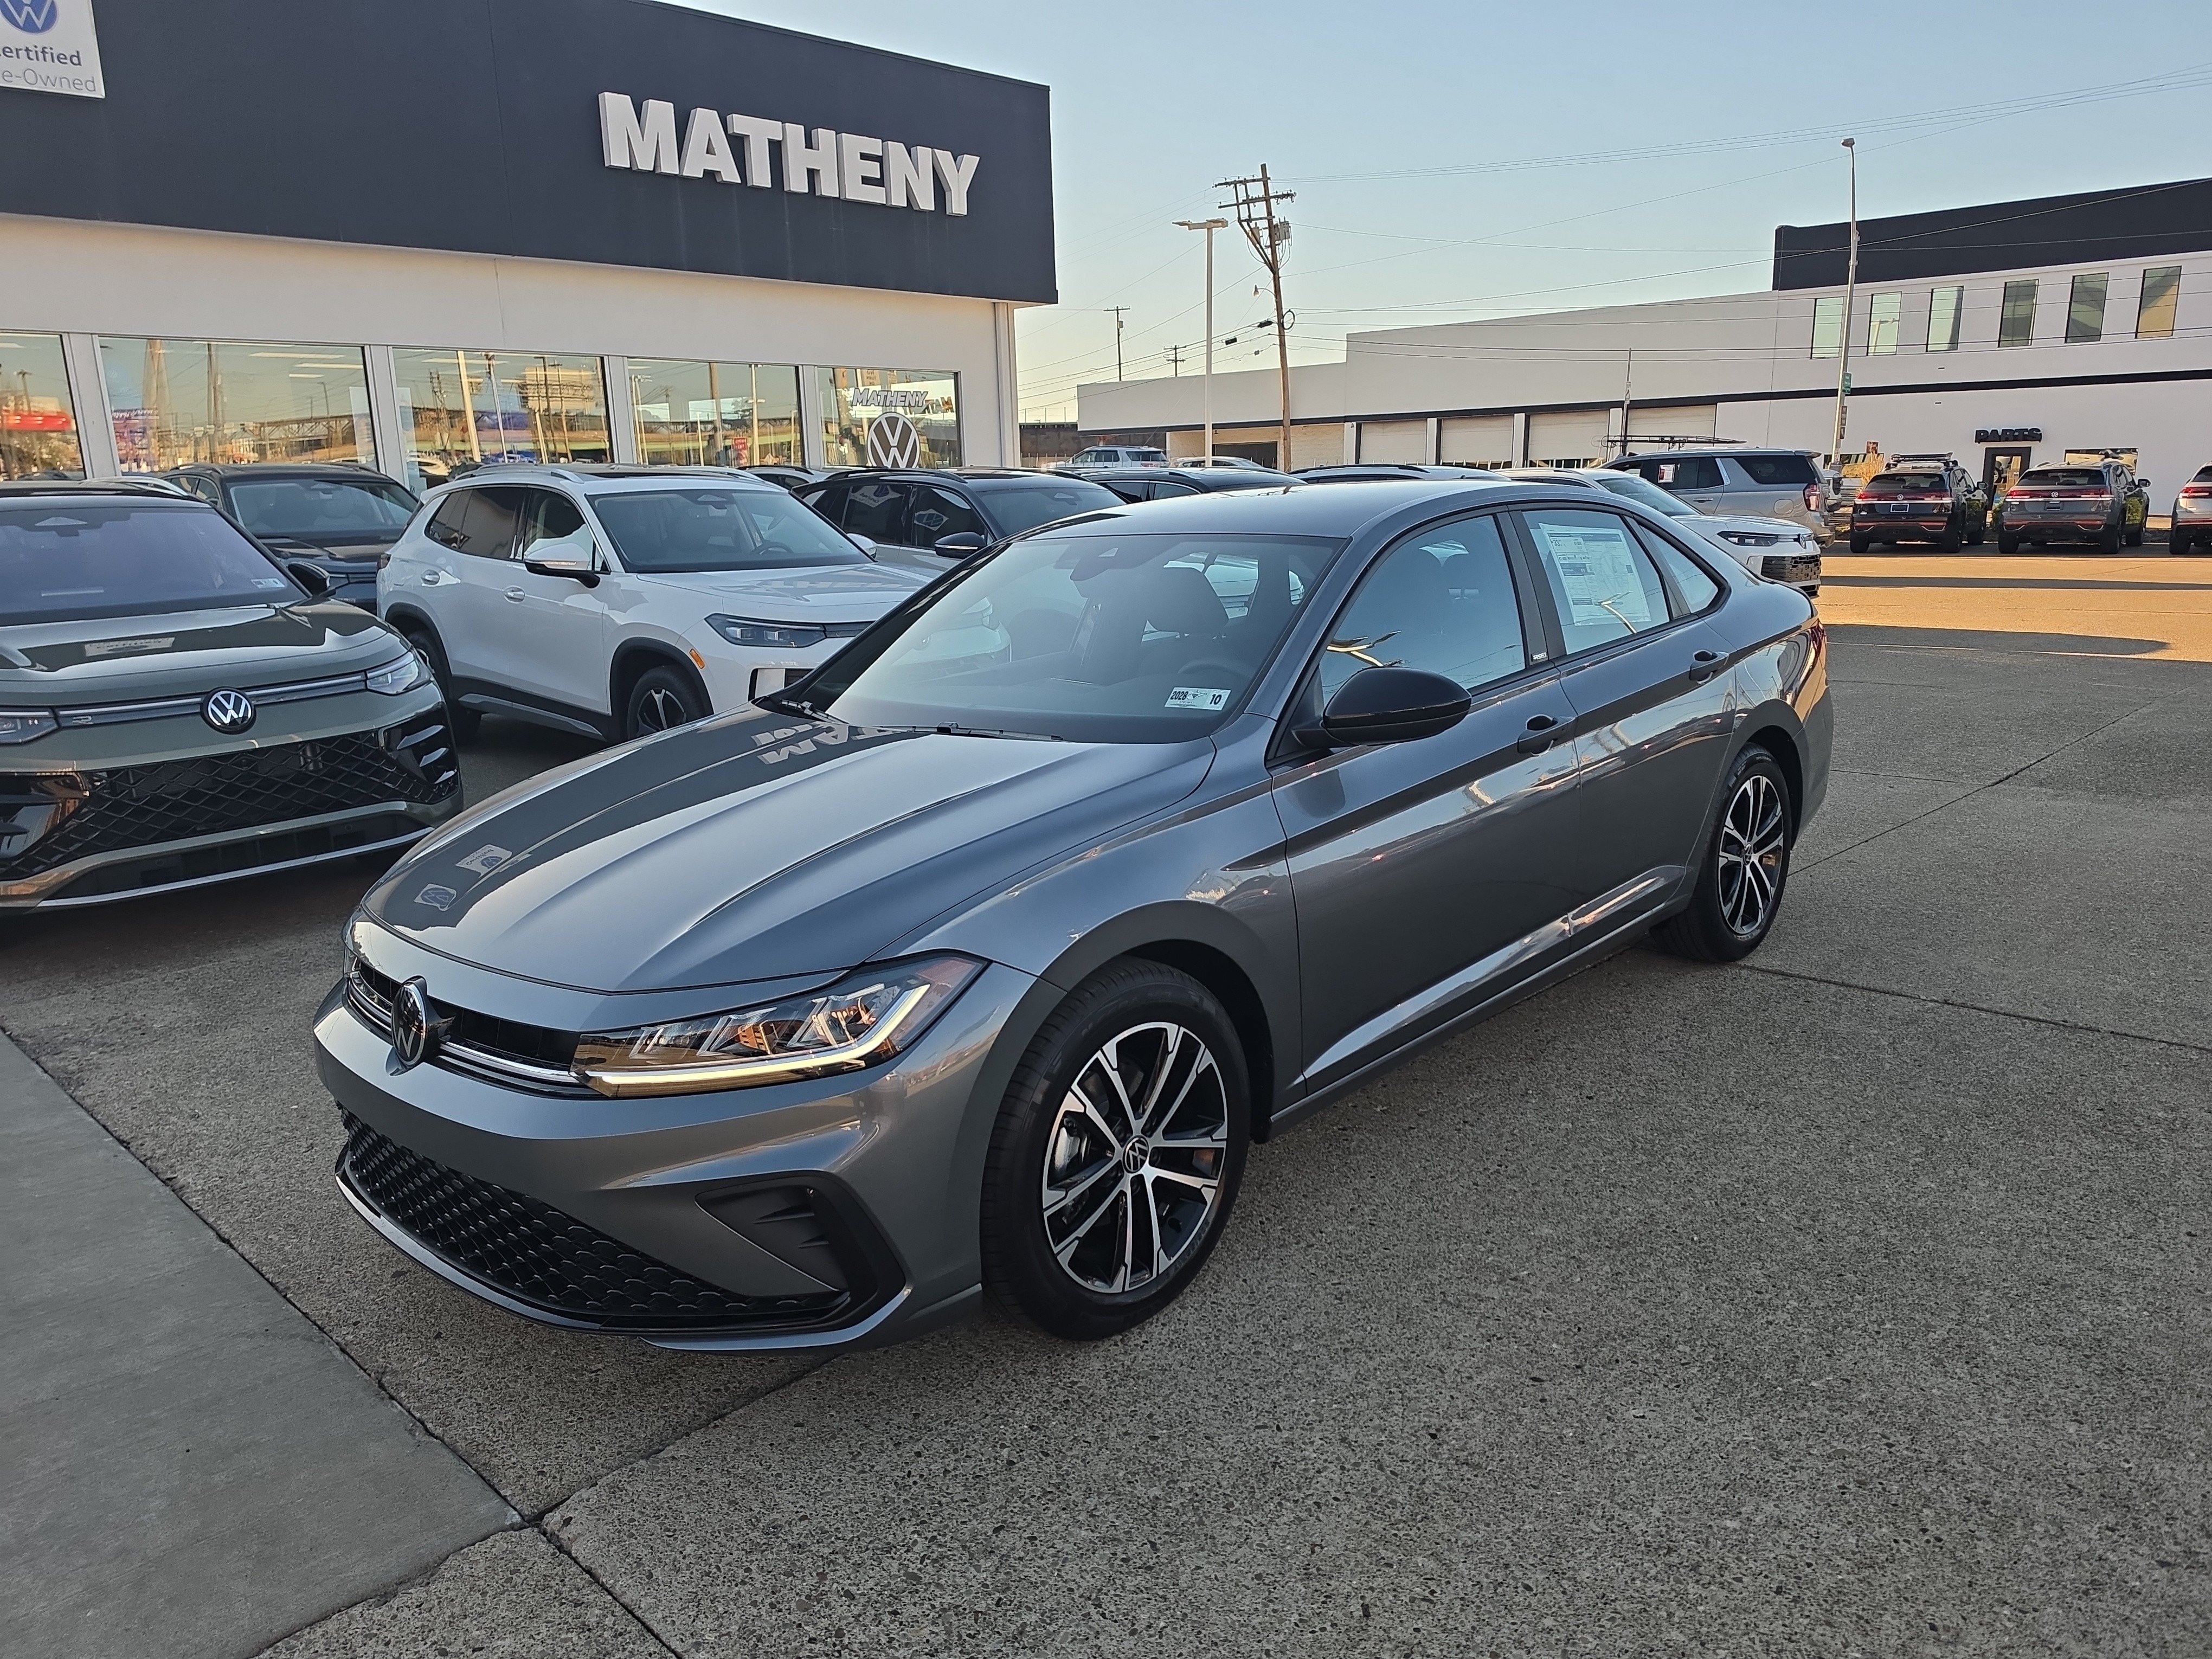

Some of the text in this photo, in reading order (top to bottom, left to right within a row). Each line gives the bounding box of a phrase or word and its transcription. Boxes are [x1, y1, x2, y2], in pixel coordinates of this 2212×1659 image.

[0, 45, 82, 66] ertified
[598, 91, 980, 216] MATHENY
[851, 388, 929, 407] MATHENY
[1975, 428, 2042, 443] PARTS
[1209, 693, 1222, 705] 10
